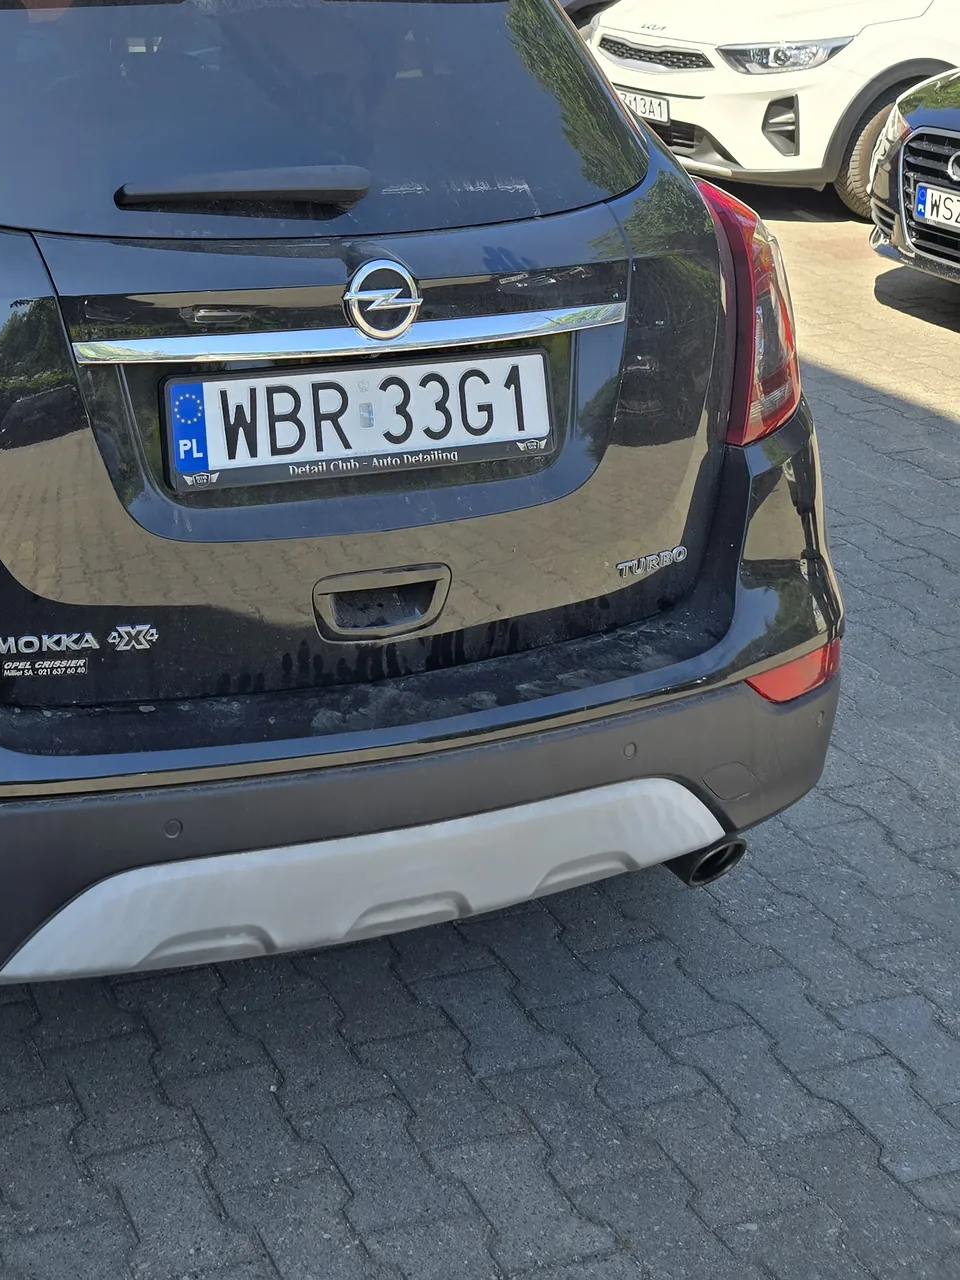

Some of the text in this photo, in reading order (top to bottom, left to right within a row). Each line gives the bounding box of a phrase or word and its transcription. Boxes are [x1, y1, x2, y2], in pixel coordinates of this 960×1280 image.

[633, 96, 663, 119] 13A1
[917, 203, 925, 213] PL
[218, 365, 527, 461] WBR 33G1
[179, 439, 204, 460] PL
[289, 461, 327, 476] Detail
[330, 459, 360, 473] Club
[371, 456, 401, 468] Auto
[403, 450, 459, 464] Detailing
[616, 545, 688, 578] TURBO
[4, 659, 86, 669] OPEL CRISSIER
[52, 667, 66, 675] 637
[76, 666, 86, 674] 40
